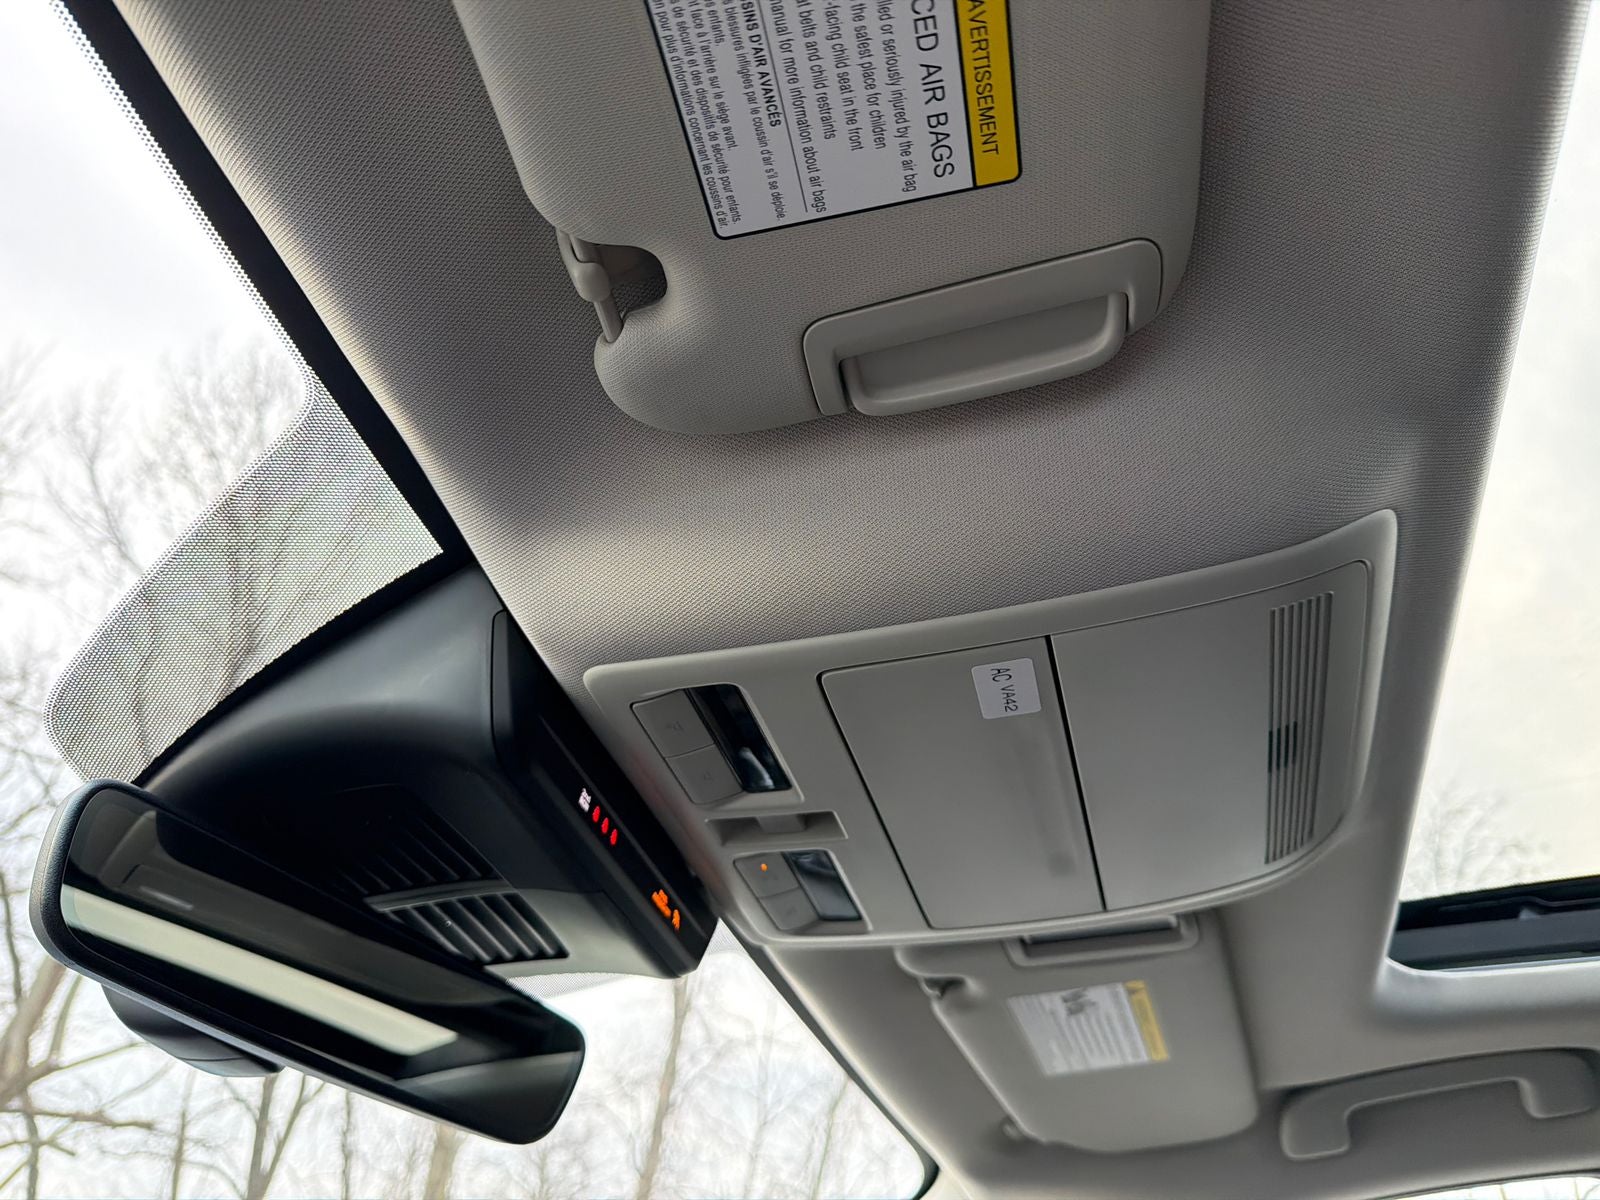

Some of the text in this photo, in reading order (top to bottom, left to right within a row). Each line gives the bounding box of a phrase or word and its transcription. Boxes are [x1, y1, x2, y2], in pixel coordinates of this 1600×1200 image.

[653, 11, 673, 32] pour
[670, 6, 686, 19] de
[690, 8, 706, 30] face
[726, 6, 746, 52] blessures
[798, 9, 818, 39] belts
[878, 24, 895, 35] or
[660, 34, 681, 54] plus
[695, 31, 711, 39] à
[777, 38, 795, 54] for
[804, 41, 825, 62] and
[685, 57, 702, 69] et
[740, 0, 784, 128] SINS D'AIR AVANCÉS
[781, 57, 800, 85] more
[881, 38, 905, 86] seriously
[671, 54, 697, 117] d'informations
[689, 69, 706, 87] des
[708, 75, 721, 91] sur
[809, 64, 830, 90] child
[823, 0, 865, 152] -facing child seat in the front
[850, 3, 888, 150] the safest place for children
[918, 63, 946, 106] AIR
[967, 0, 999, 155] AVERTISSEMENT
[713, 91, 725, 100] le
[742, 90, 760, 105] par
[693, 86, 718, 130] dispositifs
[749, 106, 765, 116] le
[788, 86, 814, 144] information
[815, 92, 839, 140] restraints
[886, 88, 911, 125] injured
[688, 117, 712, 163] concernant
[706, 129, 721, 142] de
[752, 116, 770, 148] coussin
[892, 125, 911, 139] by
[898, 140, 914, 158] the
[926, 112, 955, 178] BAGS
[760, 149, 775, 166] d'air
[801, 146, 821, 174] about
[900, 159, 917, 172] air
[701, 162, 714, 176] les
[764, 168, 779, 180] s'il
[717, 175, 734, 195] pour
[768, 180, 779, 191] se
[808, 175, 824, 189] air
[901, 173, 918, 193] bag
[705, 176, 725, 210] coussins
[810, 189, 827, 213] bags
[715, 210, 730, 229] d'air.
[990, 667, 1018, 712] AC VA42
